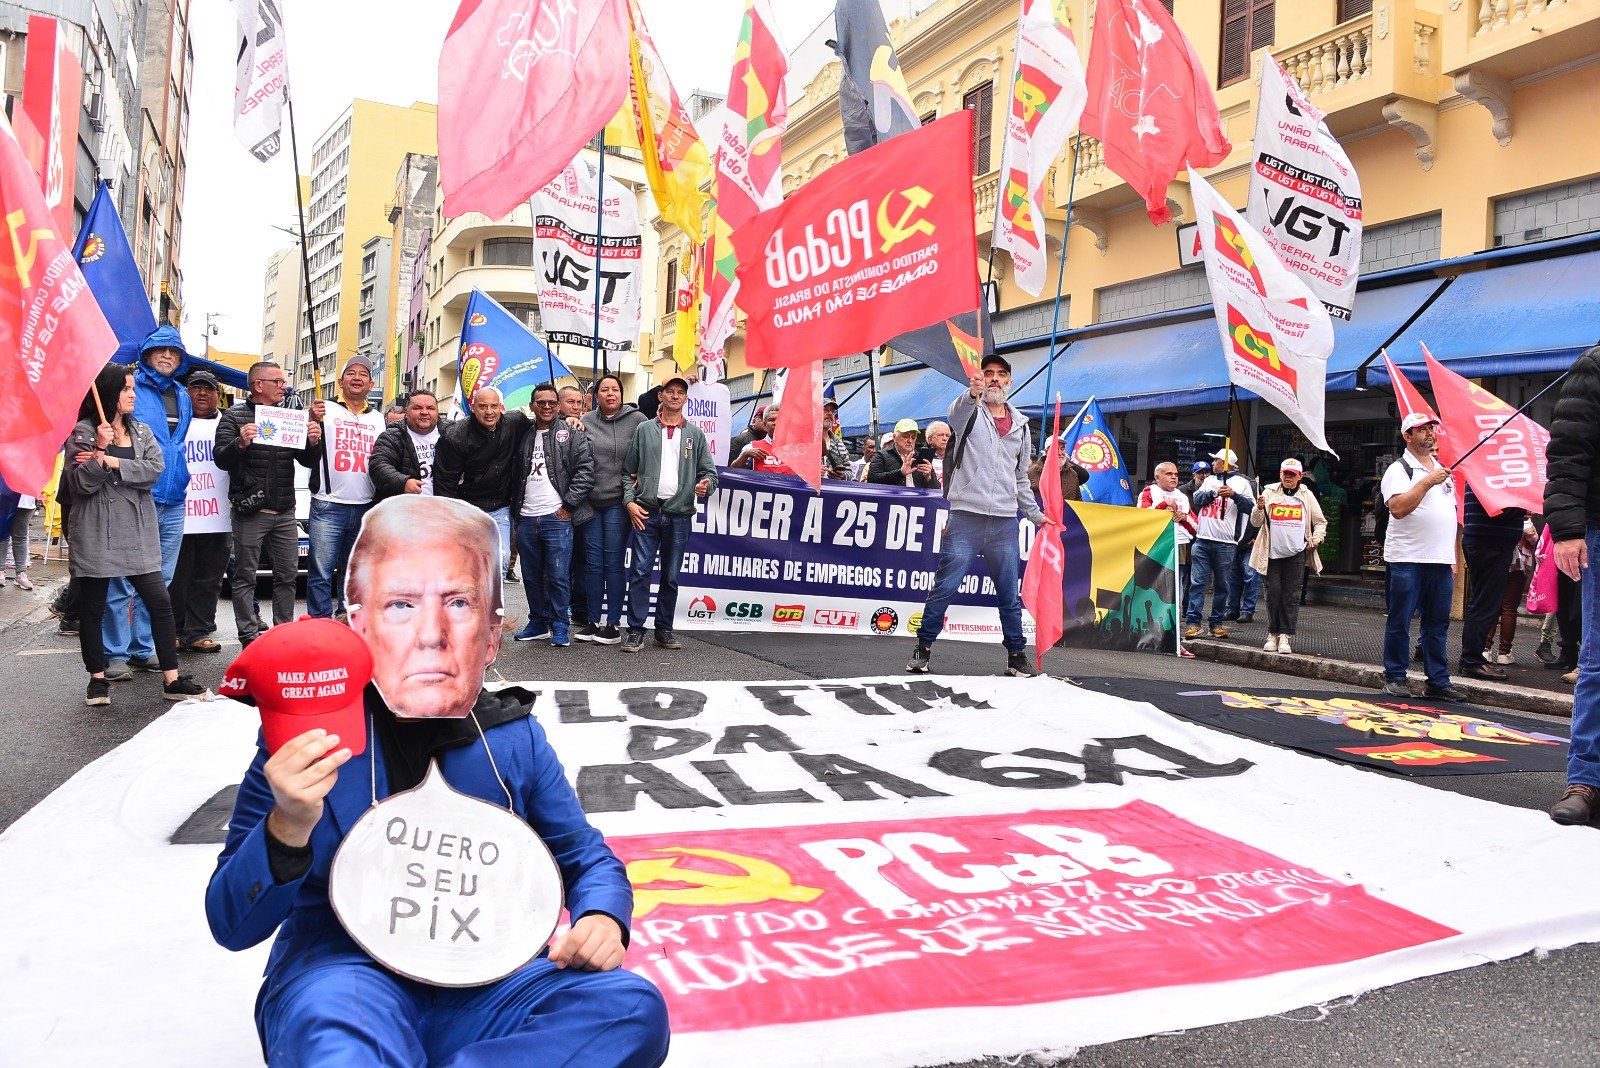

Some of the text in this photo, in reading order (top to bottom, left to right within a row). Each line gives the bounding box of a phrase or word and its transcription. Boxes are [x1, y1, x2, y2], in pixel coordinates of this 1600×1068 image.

[1278, 120, 1312, 138] UNIÃO
[1260, 165, 1280, 178] UGT
[1278, 175, 1298, 188] UGT
[1298, 183, 1319, 195] UGT
[1317, 190, 1335, 202] UGT
[1266, 157, 1285, 170] UGT
[1284, 166, 1303, 179] UGT
[1303, 174, 1323, 187] UGT
[1323, 181, 1338, 193] UGT
[1263, 188, 1350, 257] UGT
[556, 229, 576, 247] UGT
[577, 243, 597, 257] UGT
[600, 248, 620, 258] UGT
[620, 248, 639, 258] UGT
[560, 223, 580, 239] UGT
[581, 234, 598, 246] UGT
[602, 237, 621, 248] UGT
[621, 238, 638, 248] UGT
[1281, 243, 1348, 277] GERAL DOS
[542, 248, 632, 305] UGT
[552, 333, 568, 343] UGT
[602, 340, 624, 350] UGT
[1235, 323, 1280, 371] CT
[687, 397, 718, 418] BRASIL
[281, 433, 300, 443] 6X1
[335, 427, 361, 440] FIM
[186, 440, 215, 463] ASIL
[334, 450, 369, 473] 6X
[186, 497, 220, 517] ENDA
[691, 486, 794, 541] ENDER
[800, 496, 824, 544] A
[833, 499, 879, 548] 25
[885, 504, 925, 553] DE
[1272, 505, 1302, 518] CTB
[703, 553, 780, 580] MILHARES
[784, 561, 802, 582] DE
[806, 563, 882, 588] EMPREGOS
[885, 566, 894, 588] E
[897, 568, 906, 589] O
[687, 610, 716, 619] UGT
[725, 601, 764, 618] CSB
[774, 607, 804, 619] CTB
[815, 610, 855, 626] CUT
[277, 667, 349, 684] MAKE AMERICA
[281, 682, 346, 699] GREAT AGAIN
[554, 686, 708, 723] LO
[626, 724, 802, 761] DA
[576, 751, 955, 813] ALA
[385, 816, 500, 866] QUERO
[406, 862, 478, 897] SEU
[631, 909, 828, 948] ARTIDO
